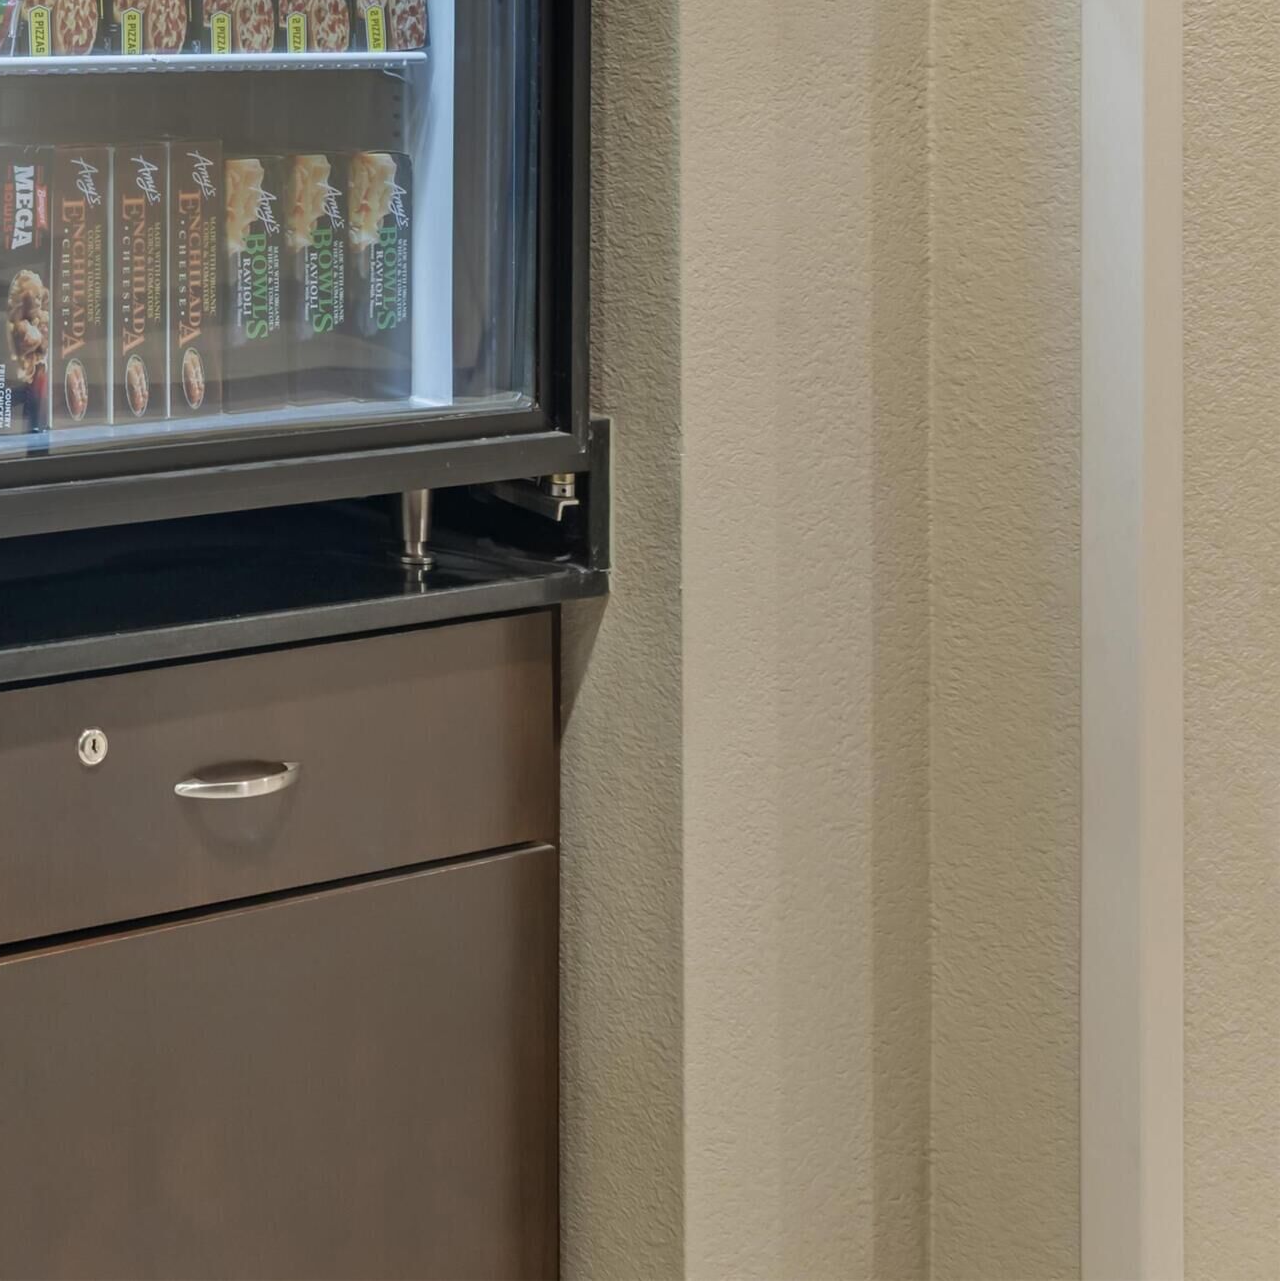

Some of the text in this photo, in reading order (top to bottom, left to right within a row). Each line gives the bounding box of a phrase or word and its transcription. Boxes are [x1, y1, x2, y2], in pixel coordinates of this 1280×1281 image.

[34, 20, 45, 54] PIZZAS
[370, 17, 382, 49] PIZZAS
[70, 157, 101, 208] Amy's
[131, 154, 160, 206] Amy's
[186, 150, 216, 200] Amy's
[11, 165, 34, 250] MEGA
[249, 186, 280, 237] Amy's
[316, 182, 345, 231] Amy's
[384, 179, 409, 230] Amy's
[62, 197, 86, 358] ENCHILADA
[62, 238, 70, 317] CHEESE
[122, 236, 131, 313] CHEESE
[122, 194, 145, 356] ENCHILADA
[178, 189, 202, 348] ENCHILADA
[178, 230, 186, 307] CHEESE
[242, 232, 268, 340] BOWLS
[242, 258, 251, 316] RAVIOLI
[310, 252, 318, 309] RAVIOLI
[311, 226, 334, 333] BOWLS
[375, 250, 384, 306] RAVIOLI
[377, 225, 397, 330] BOWLS
